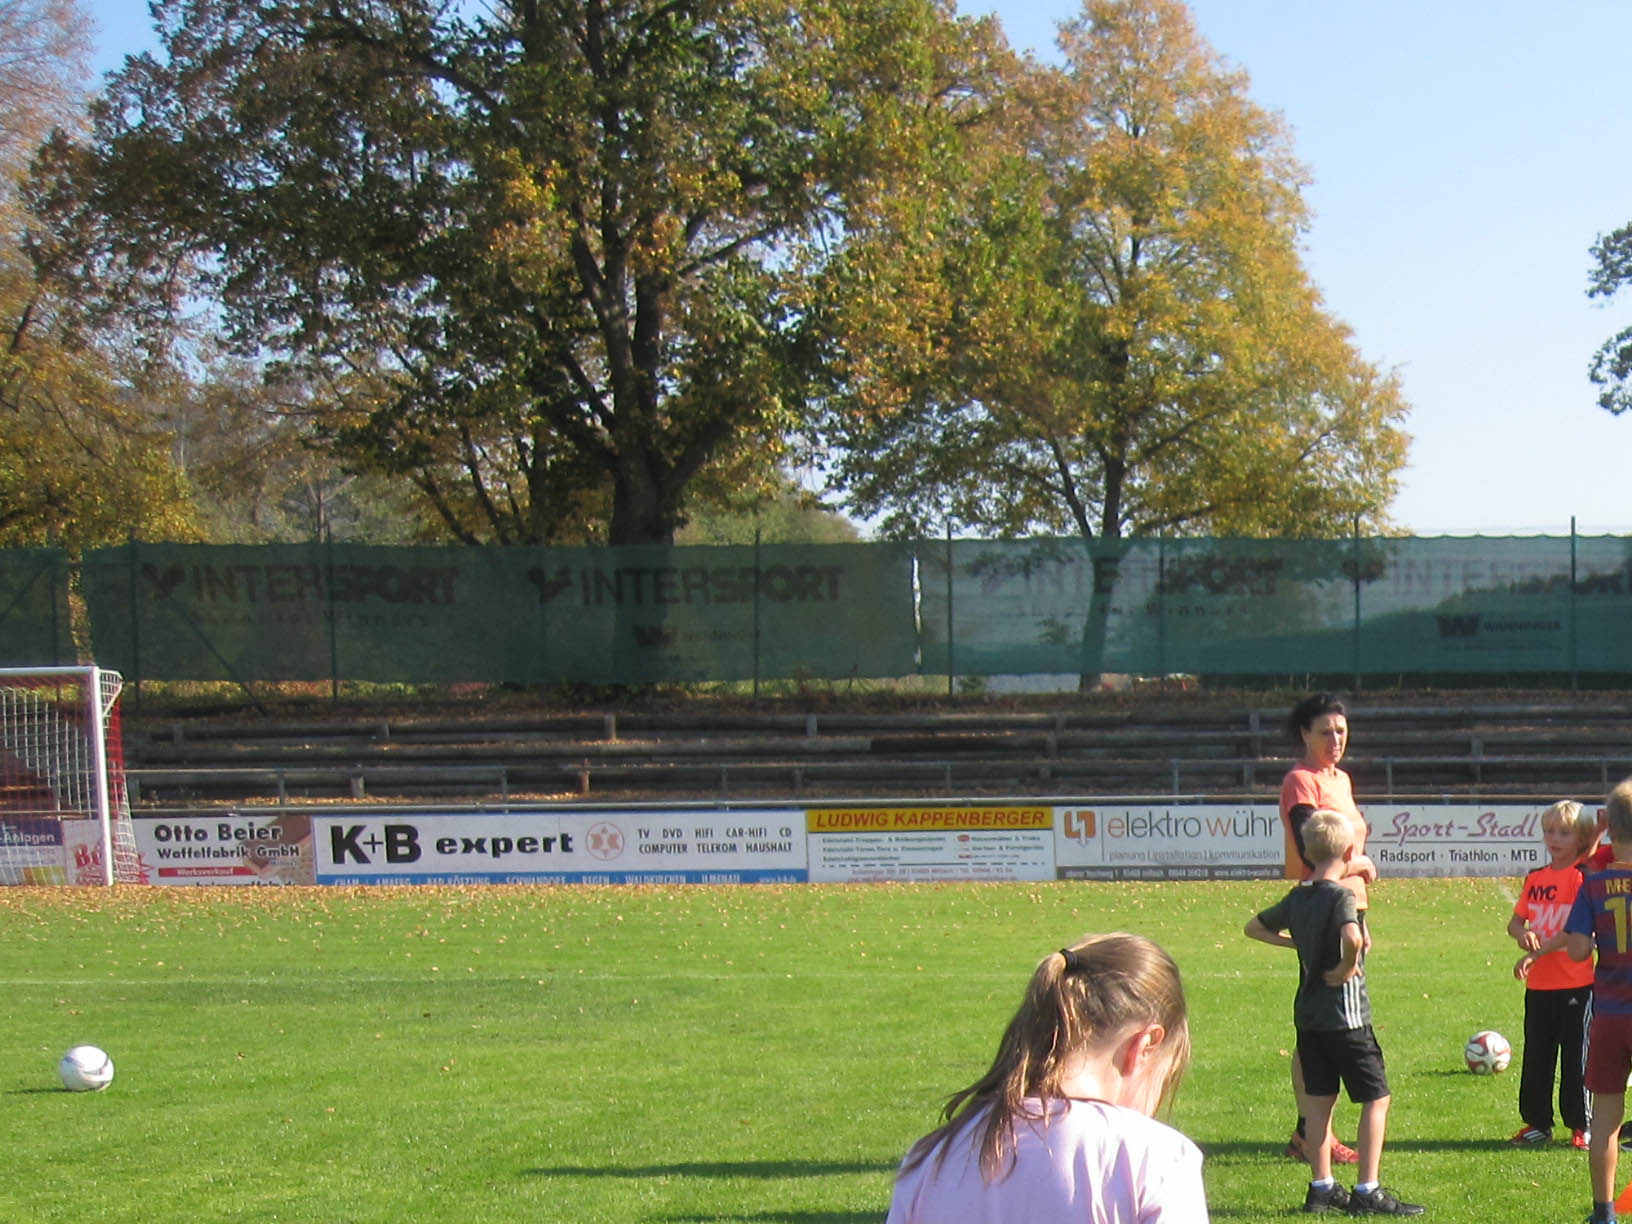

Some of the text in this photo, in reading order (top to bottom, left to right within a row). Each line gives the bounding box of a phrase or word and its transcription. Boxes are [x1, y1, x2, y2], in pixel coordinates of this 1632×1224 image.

[193, 564, 459, 604] INTERSPORT
[581, 565, 845, 605] INTERSPORT
[816, 810, 1045, 828] LUDWIG KAPPENBERGER
[154, 821, 281, 842] Otto Beier
[638, 826, 792, 840] TV DVD HIFI CAR-HIFI CD
[1382, 811, 1542, 846] Sport-Stadl
[157, 845, 300, 860] Waffelfabrik GmbH
[330, 825, 574, 865] K+B expert
[638, 841, 793, 855] COMPUTER TELEKOM HAUSHALT
[1208, 848, 1280, 862] kommunikation
[1380, 850, 1537, 863] Radsport Triathlon MTB
